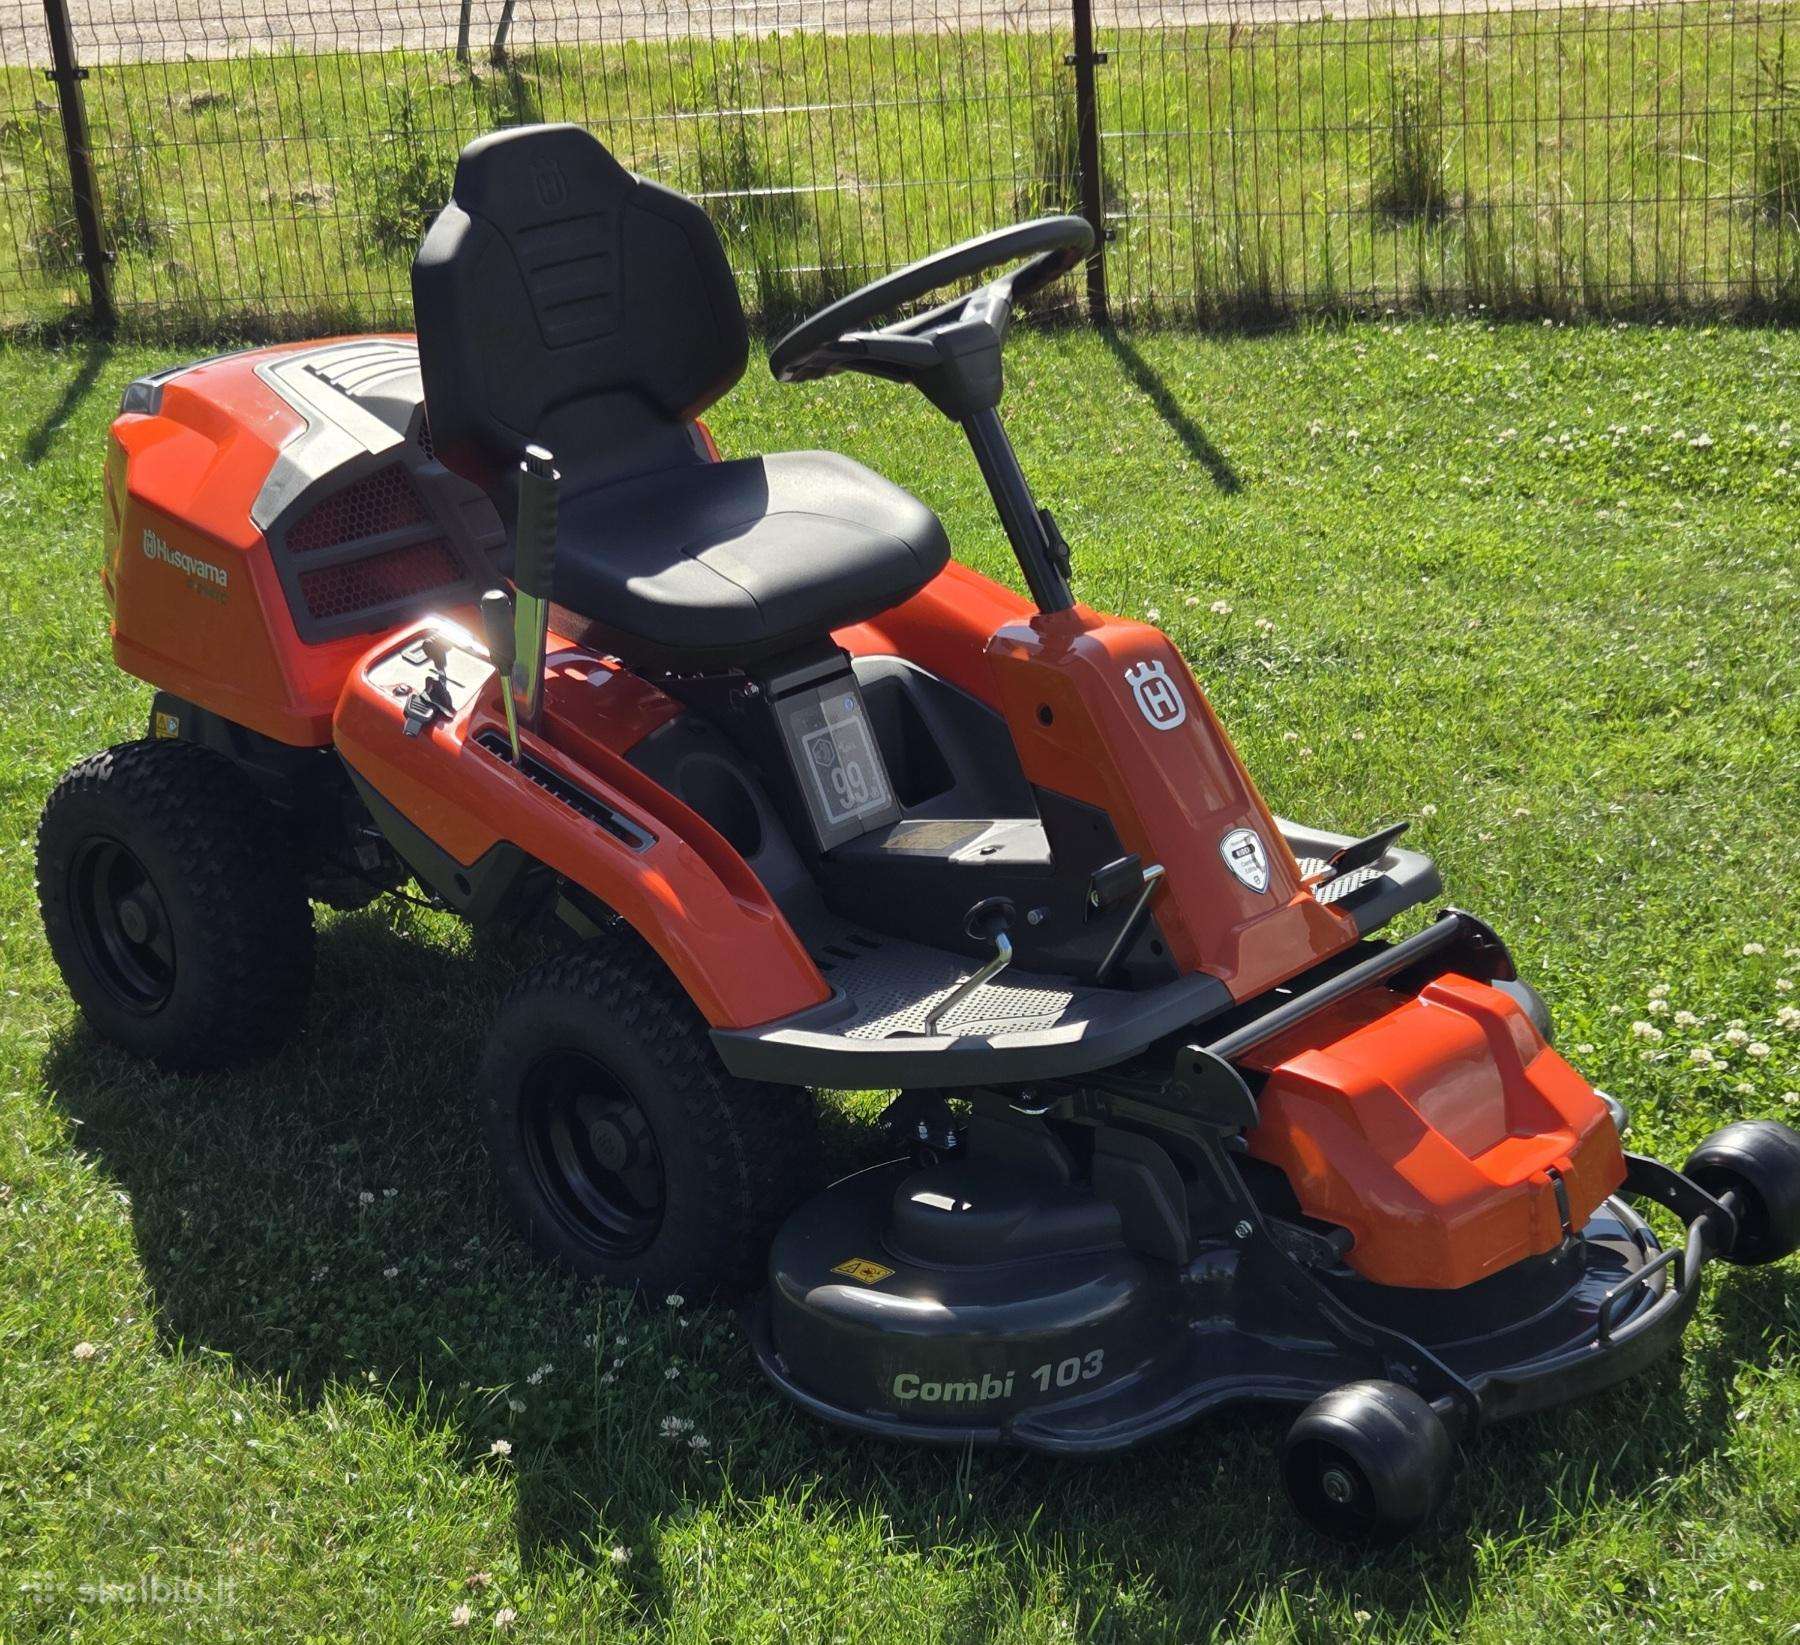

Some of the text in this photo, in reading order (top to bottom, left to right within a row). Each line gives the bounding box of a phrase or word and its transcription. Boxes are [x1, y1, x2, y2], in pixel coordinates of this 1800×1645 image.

[156, 537, 227, 587] Husqvarna
[831, 761, 869, 809] 99
[892, 1349, 1104, 1401] Combi 103
